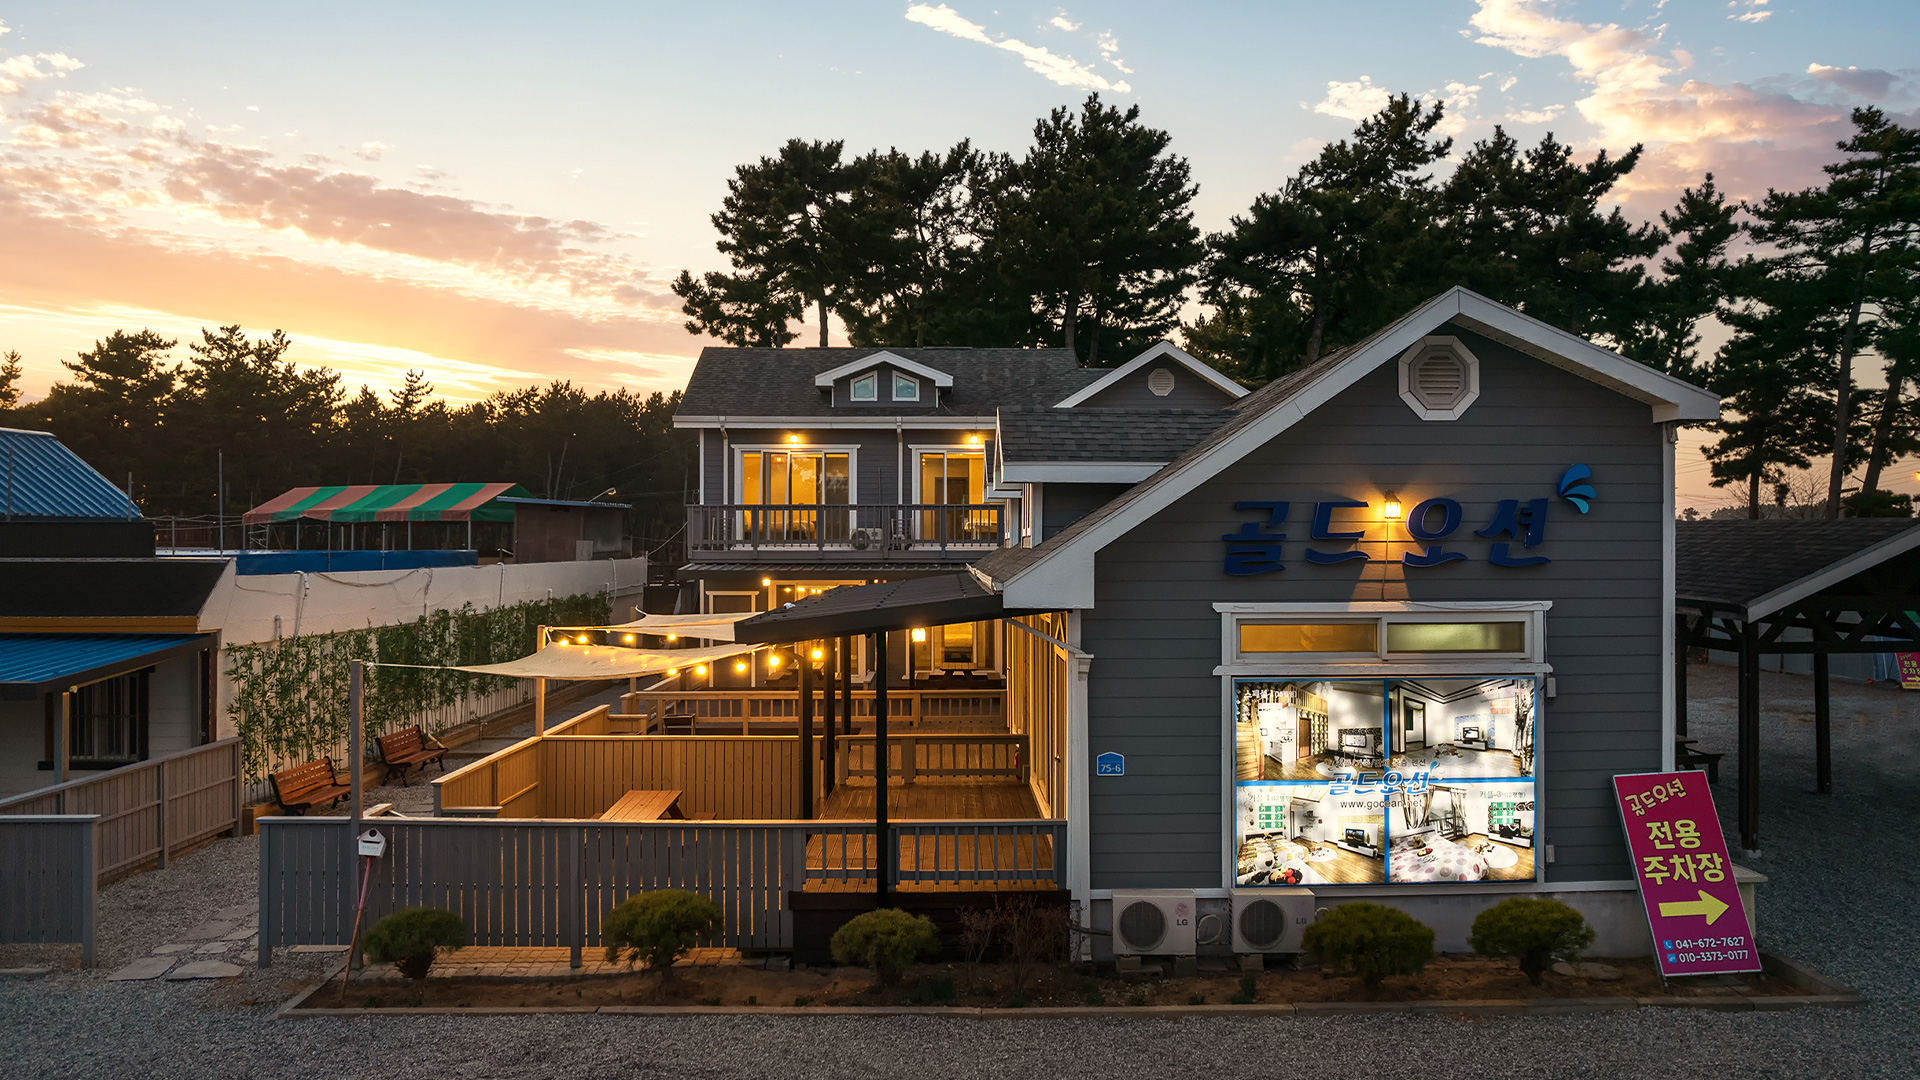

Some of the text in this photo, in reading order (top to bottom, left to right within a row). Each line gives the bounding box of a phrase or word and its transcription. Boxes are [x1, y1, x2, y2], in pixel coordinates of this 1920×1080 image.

[1222, 497, 1551, 576] 골드오션
[1100, 764, 1122, 773] 75-6
[1329, 771, 1430, 795] 골드오션
[1624, 778, 1688, 817] 골드오션
[1646, 819, 1702, 850] 전용
[1643, 852, 1726, 886] 주차장
[1296, 917, 1308, 925] LG
[1675, 936, 1745, 949] 041-672-7627
[1678, 949, 1749, 963] 010-3373-0177
